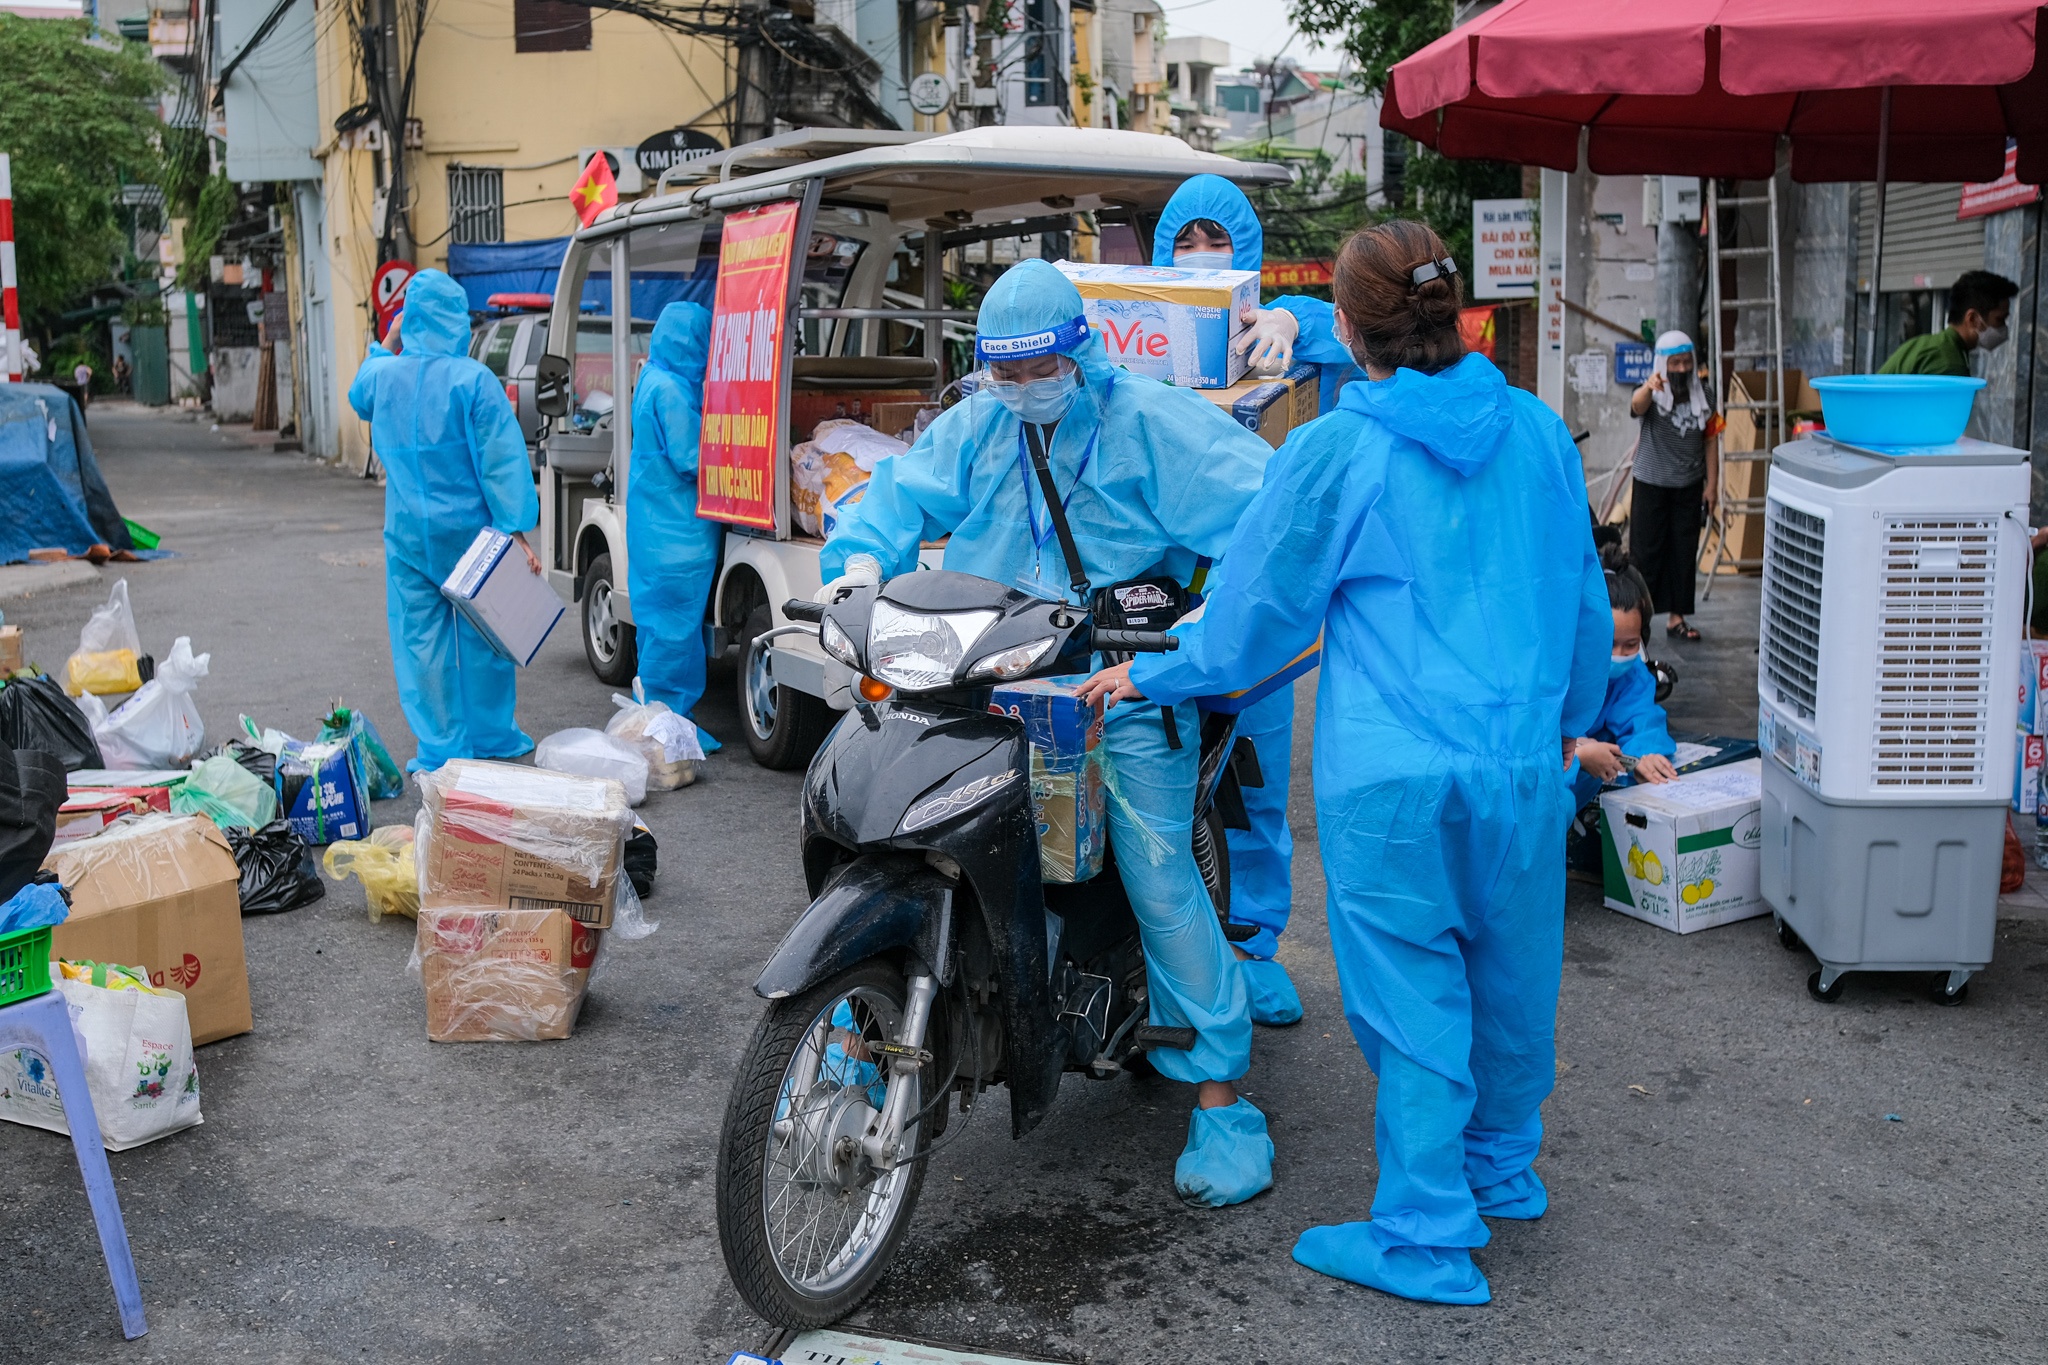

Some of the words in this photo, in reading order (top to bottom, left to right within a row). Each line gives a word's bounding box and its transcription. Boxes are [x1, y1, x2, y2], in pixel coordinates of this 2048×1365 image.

[640, 150, 669, 169] KIM
[1494, 249, 1514, 259] CHO
[1489, 265, 1512, 275] MUA
[722, 310, 751, 383] CUNG
[750, 289, 776, 383] ỨNG
[1102, 318, 1169, 357] Vie
[985, 341, 1008, 352] Face
[1012, 335, 1051, 351] Shield
[1167, 374, 1174, 382] 24
[1175, 374, 1194, 382] bottles
[1199, 376, 1208, 384] 350
[1210, 377, 1218, 385] ml
[750, 408, 768, 447] DÂN
[734, 461, 753, 500] CÁCH
[753, 469, 763, 502] LY
[1124, 594, 1163, 608] SPIDER-MAN
[885, 712, 931, 727] HONDA
[2028, 743, 2042, 759] 6
[514, 851, 528, 859] NET
[513, 860, 553, 870] CONTENTS:
[520, 869, 538, 877] Packs
[142, 1039, 174, 1052] Espace
